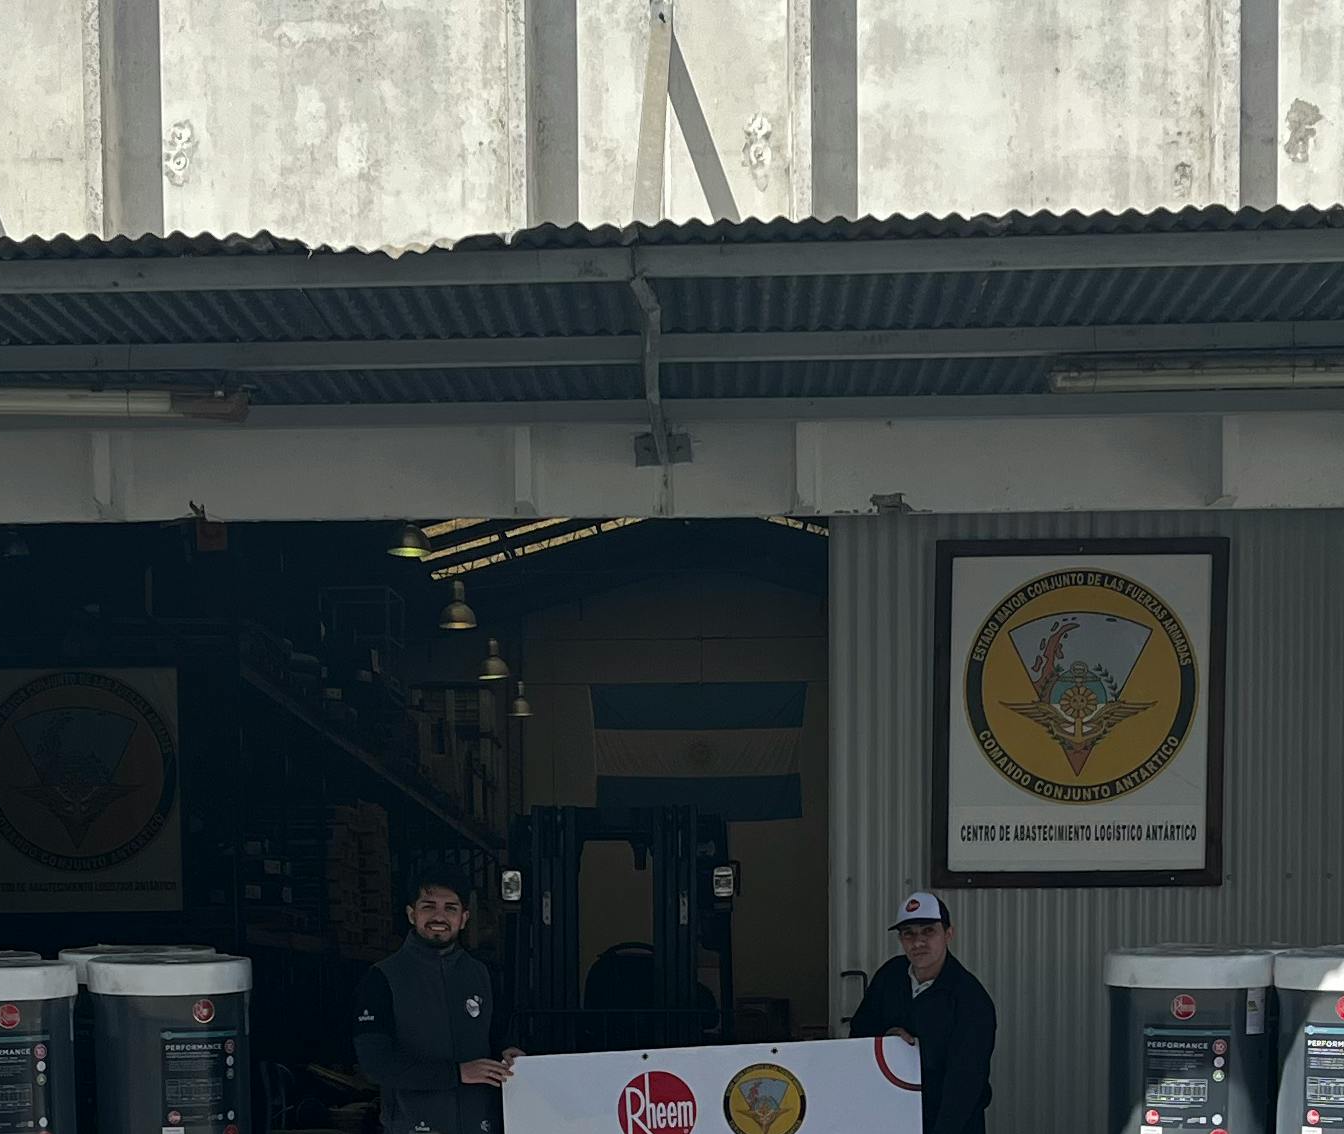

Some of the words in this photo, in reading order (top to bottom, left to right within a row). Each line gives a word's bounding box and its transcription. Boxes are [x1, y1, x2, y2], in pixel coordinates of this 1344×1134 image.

[972, 623, 1000, 662] ESTADO
[995, 591, 1026, 624] MAYOR
[1026, 573, 1085, 599] CONJUNTO
[1086, 573, 1102, 586] DE
[1103, 575, 1125, 592] LAS
[1124, 584, 1168, 621] FUERZAS
[1162, 616, 1193, 667] ARMADAS
[978, 729, 1032, 787] COMANDO
[1033, 778, 1111, 801] CONJUNTO
[960, 825, 996, 842] CENTRO
[999, 825, 1011, 841] DE
[1014, 825, 1092, 841] ABASTECIMIENTO
[1094, 822, 1143, 841] LOGÍSTICO
[1145, 821, 1197, 841] ANTÁRTICO
[165, 1043, 222, 1051] PERFORMANCE
[1147, 1041, 1208, 1050] PERFORMANCE
